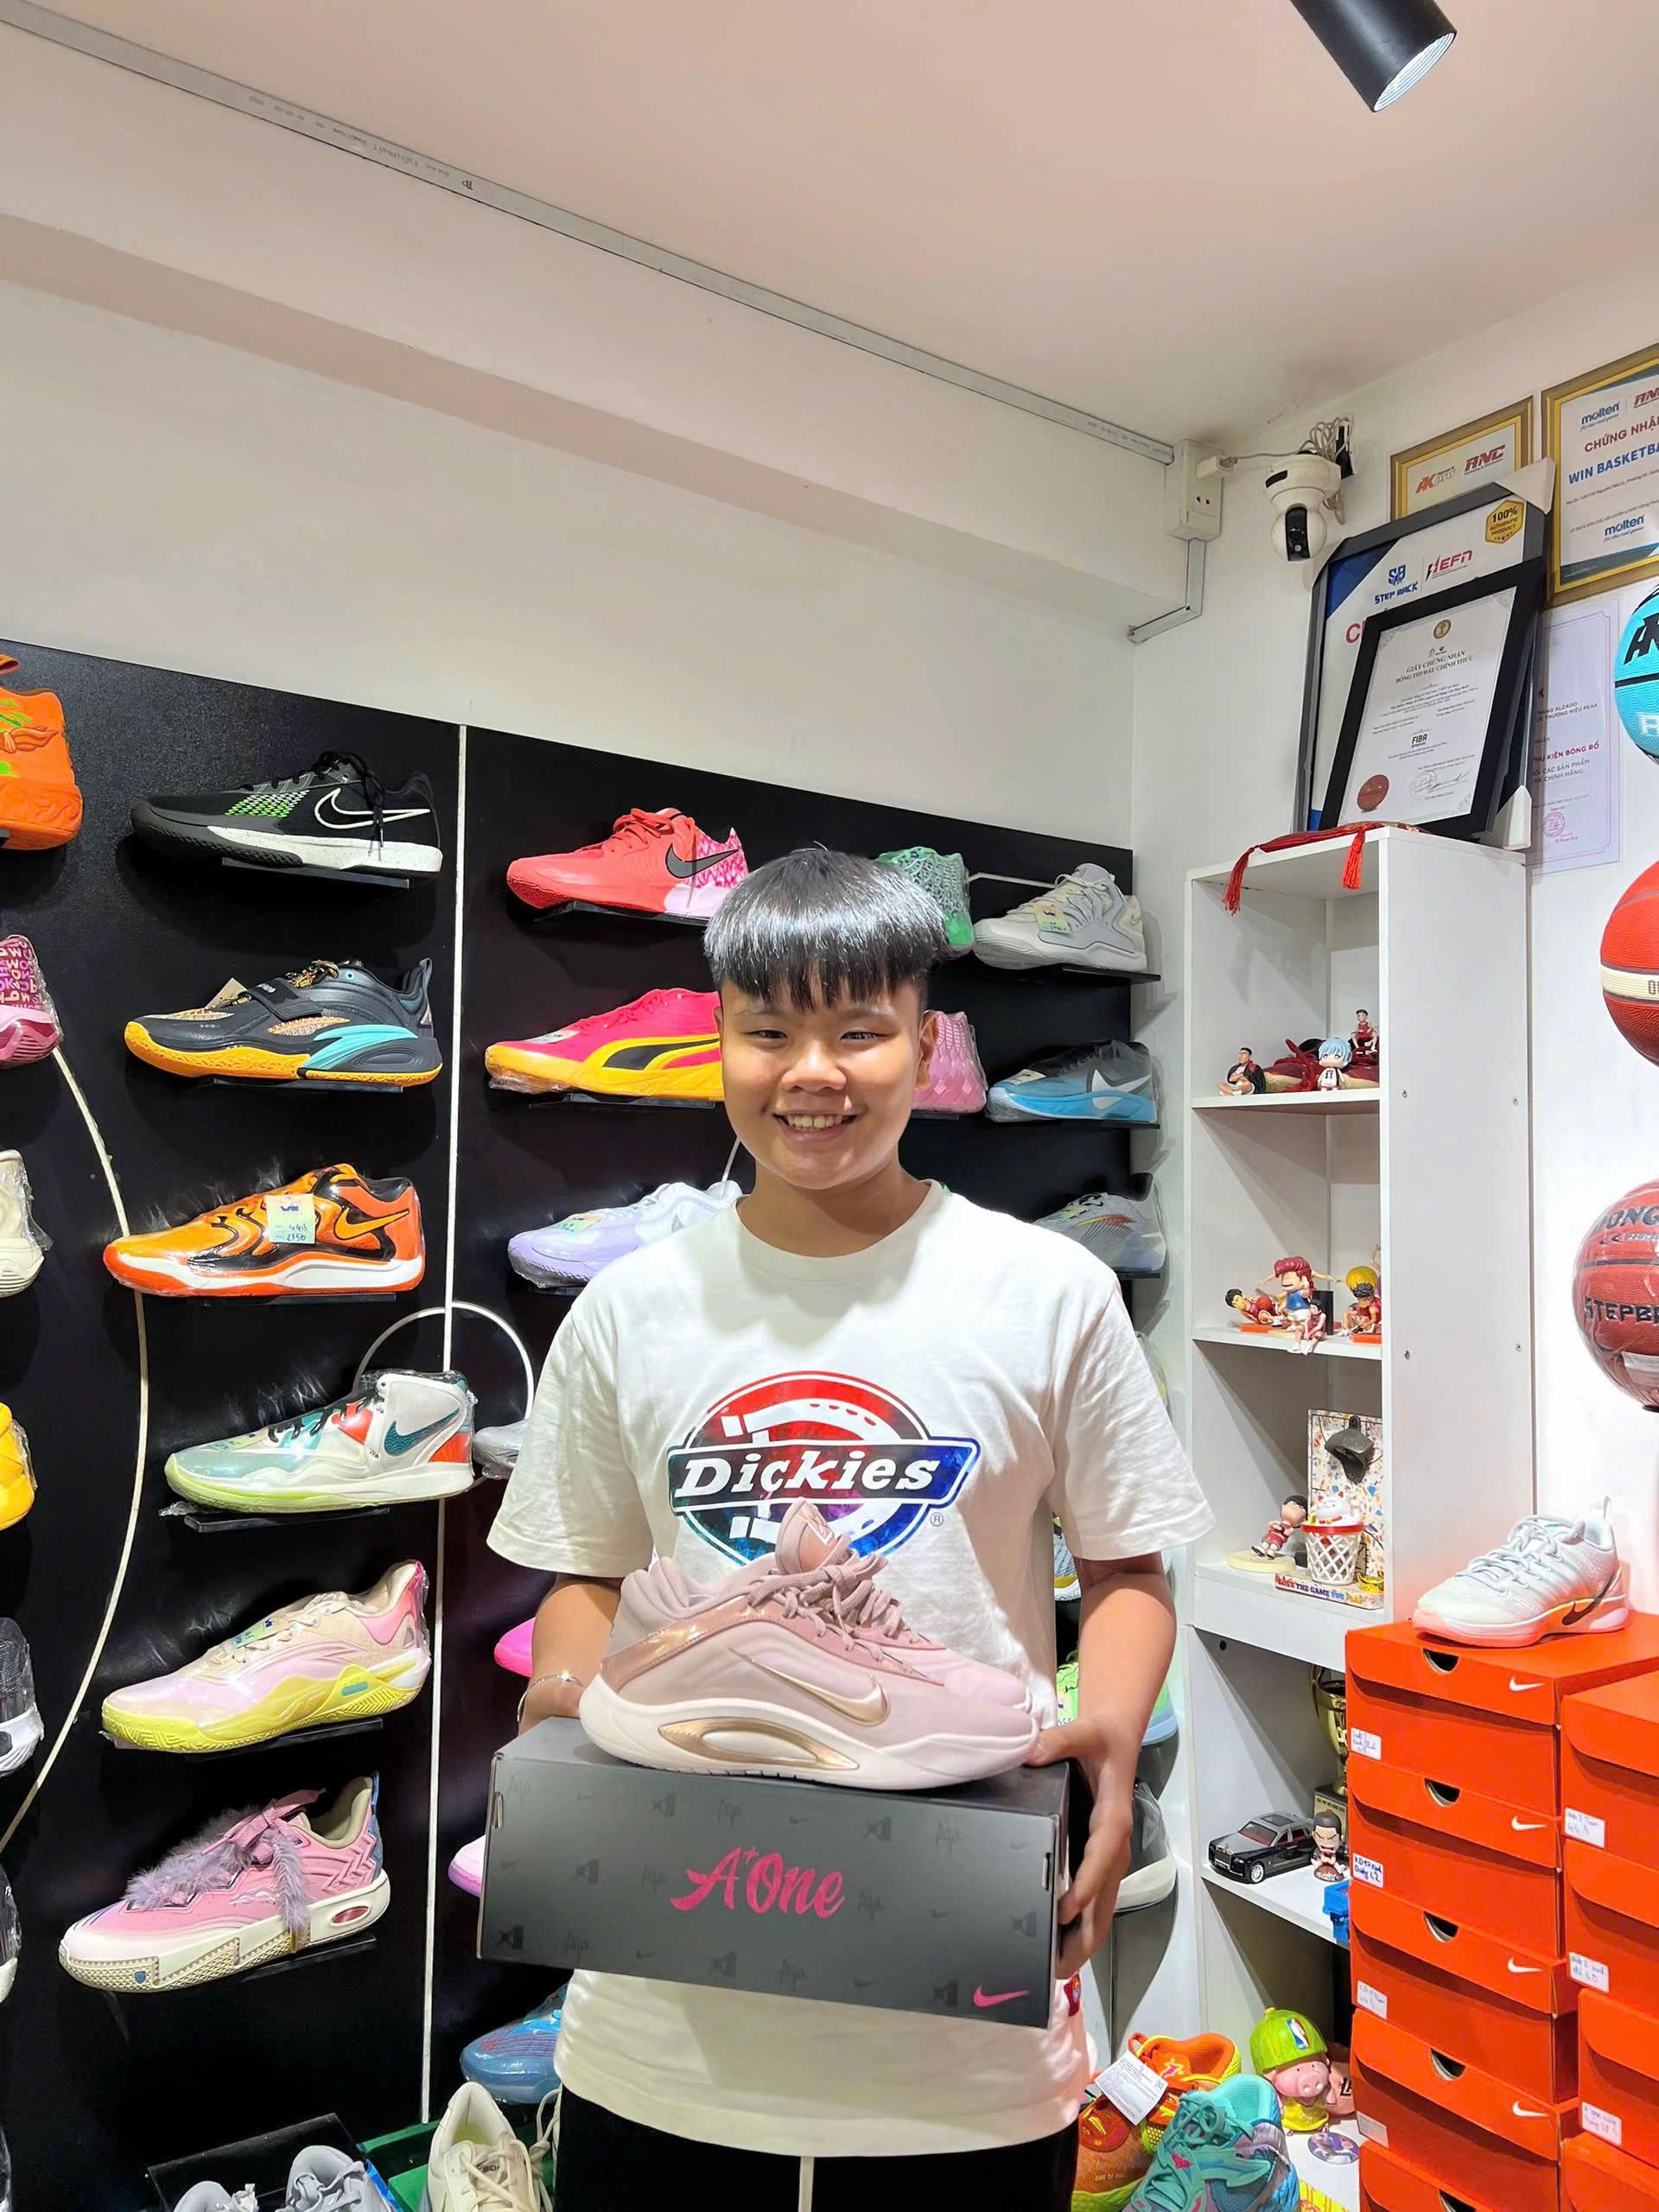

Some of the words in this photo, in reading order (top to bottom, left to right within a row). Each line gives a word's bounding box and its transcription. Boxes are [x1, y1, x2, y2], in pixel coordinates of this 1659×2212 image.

[1581, 403, 1620, 424] molten
[1630, 416, 1659, 435] NHẬ
[1568, 467, 1593, 484] WIN
[1491, 506, 1518, 523] 100%
[1605, 514, 1645, 536] molten
[1375, 591, 1395, 605] STEP
[673, 1450, 940, 1498] Dickies
